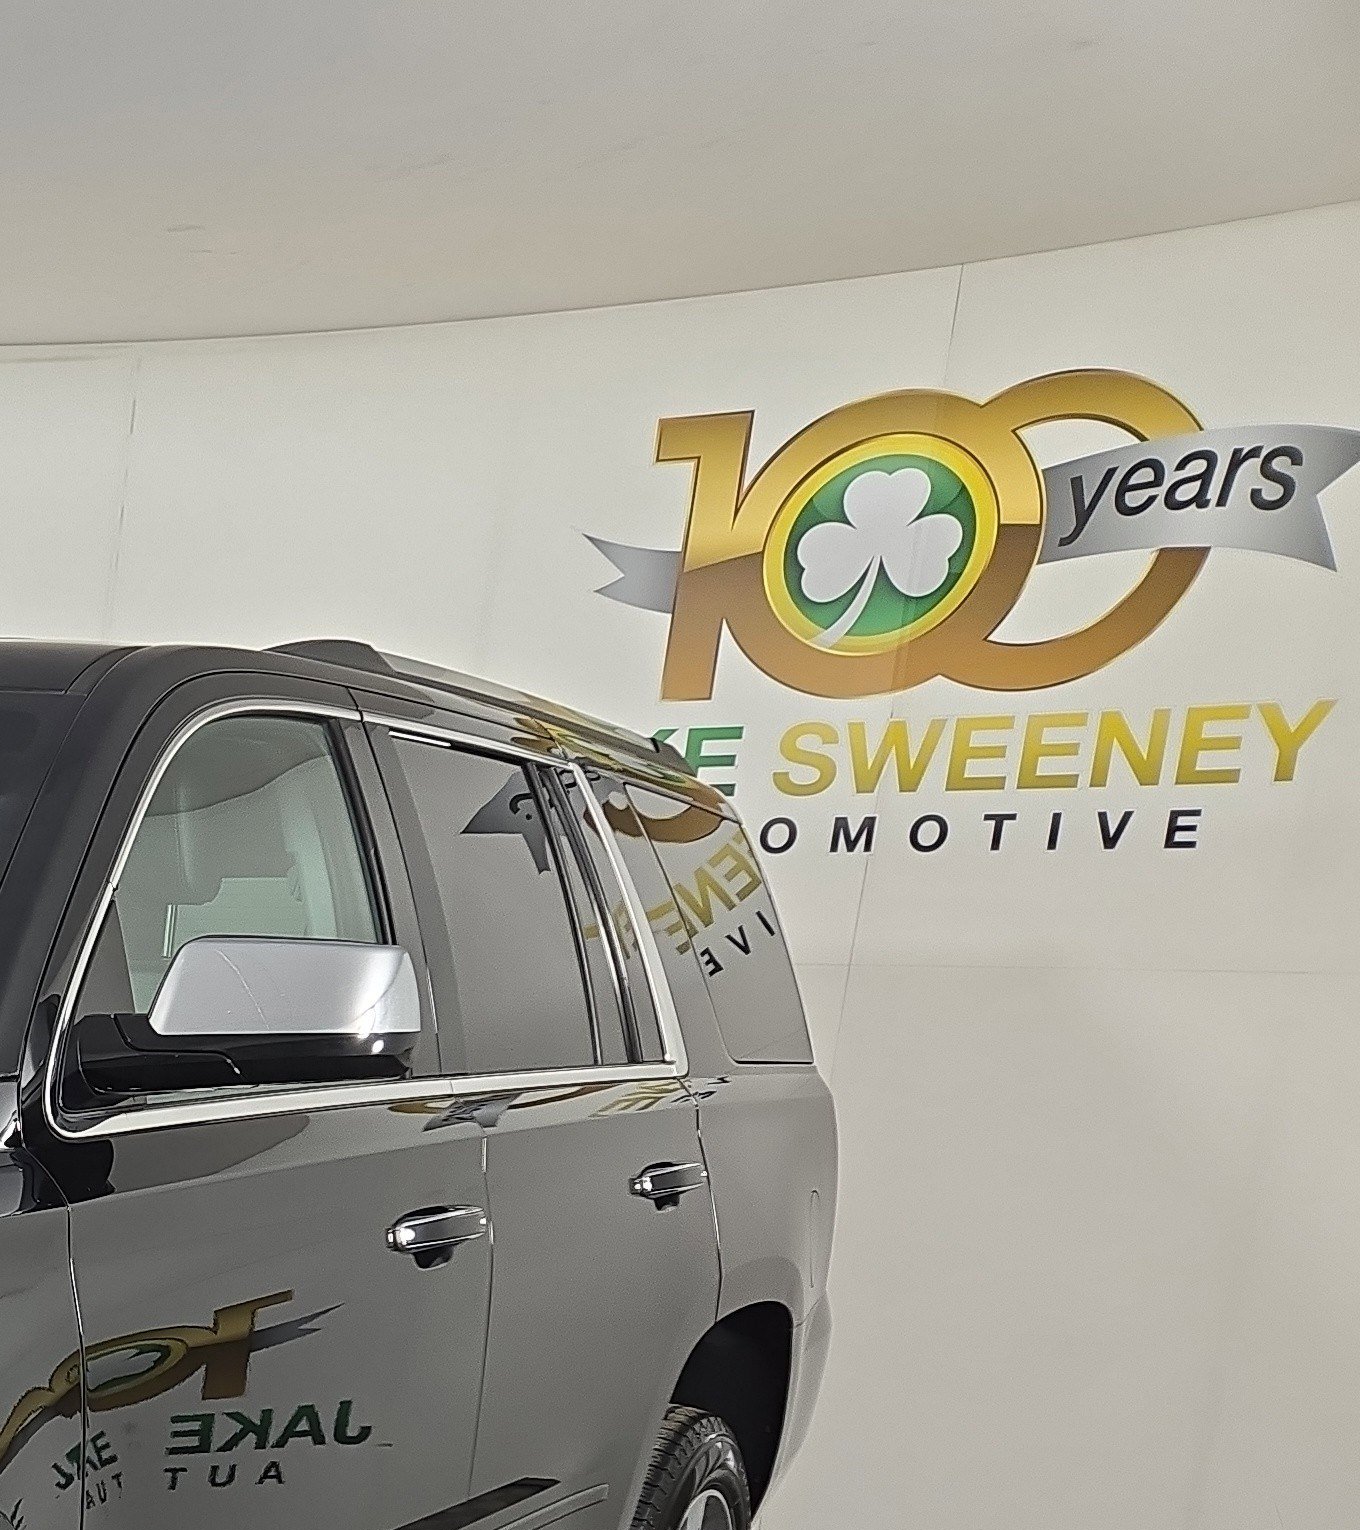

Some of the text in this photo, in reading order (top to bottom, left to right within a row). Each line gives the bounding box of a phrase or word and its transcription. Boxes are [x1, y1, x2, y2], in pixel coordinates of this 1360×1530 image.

[653, 367, 1305, 702] 100 years
[771, 698, 1338, 799] SWEENEY
[758, 808, 1203, 855] OMOTIVE
